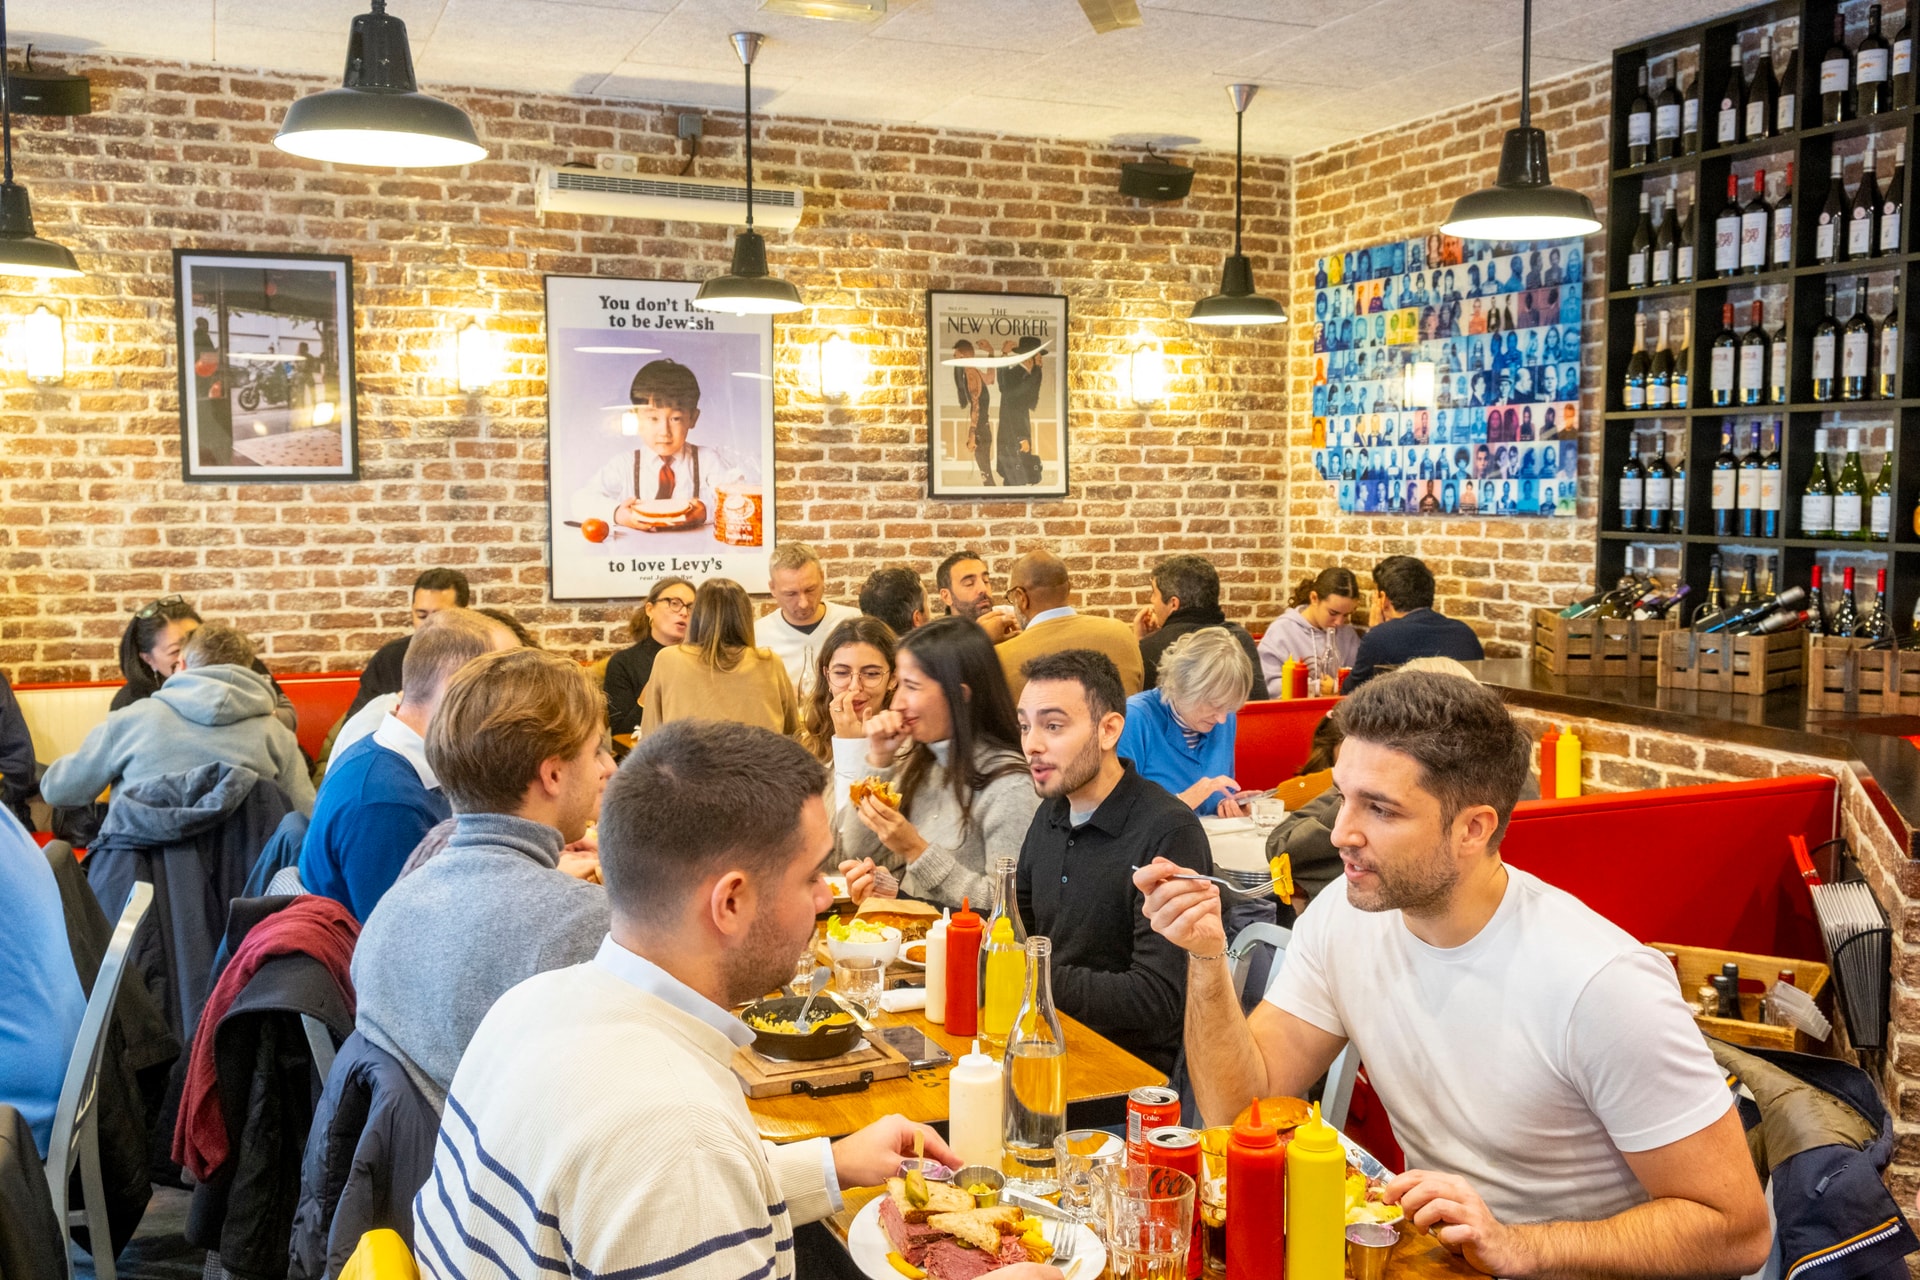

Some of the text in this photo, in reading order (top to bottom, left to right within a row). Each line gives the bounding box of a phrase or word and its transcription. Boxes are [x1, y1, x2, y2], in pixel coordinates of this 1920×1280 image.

[599, 295, 630, 310] You
[636, 297, 678, 312] don't
[990, 308, 1007, 316] THE
[609, 314, 626, 327] to
[632, 314, 651, 328] be
[948, 316, 1048, 337] NEW YORKER
[608, 557, 722, 573] to love Levy's
